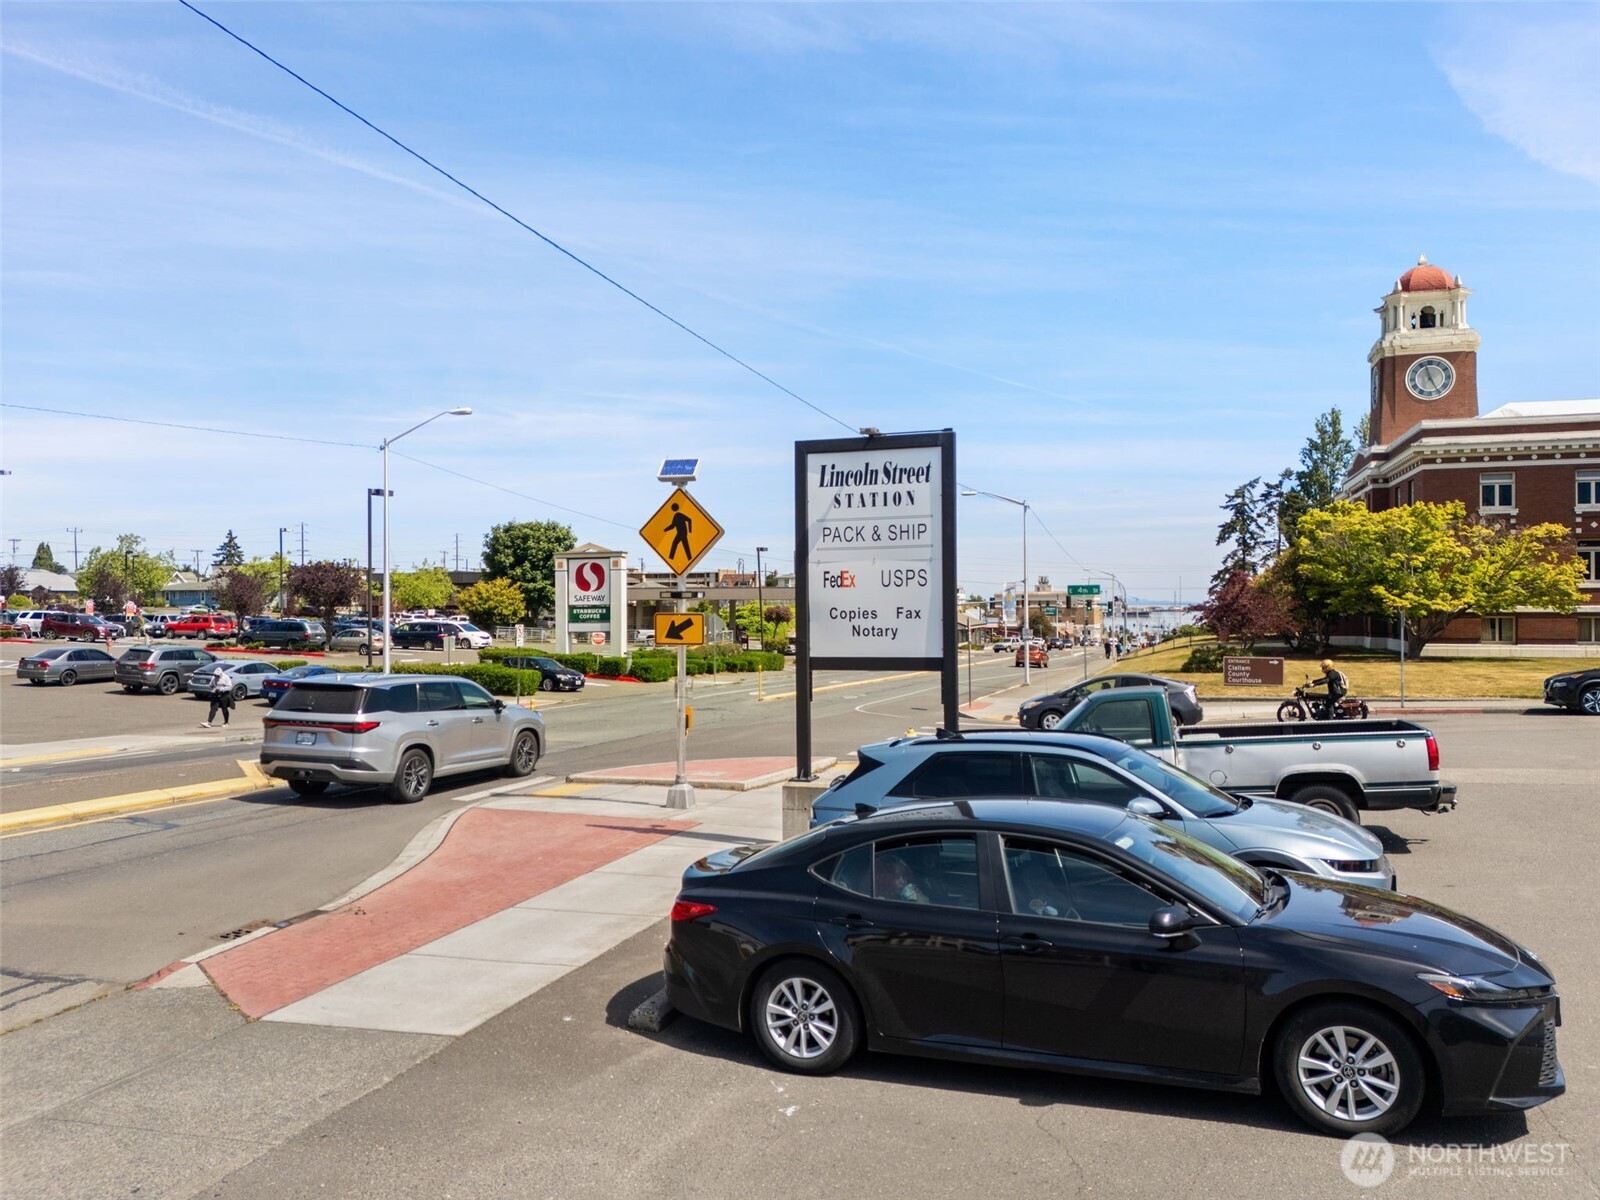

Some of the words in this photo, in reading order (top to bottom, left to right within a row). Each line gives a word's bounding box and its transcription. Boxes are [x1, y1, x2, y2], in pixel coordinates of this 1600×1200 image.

[818, 462, 879, 488] Lincoln
[882, 460, 932, 485] Street
[833, 490, 915, 508] STATION
[822, 526, 866, 543] PACK
[872, 525, 882, 542] &
[888, 523, 928, 541] SHIP
[823, 570, 856, 588] FedEx
[881, 569, 928, 588] USPS
[829, 607, 878, 622] Copies
[896, 606, 921, 619] Fax
[852, 624, 898, 640] Notary
